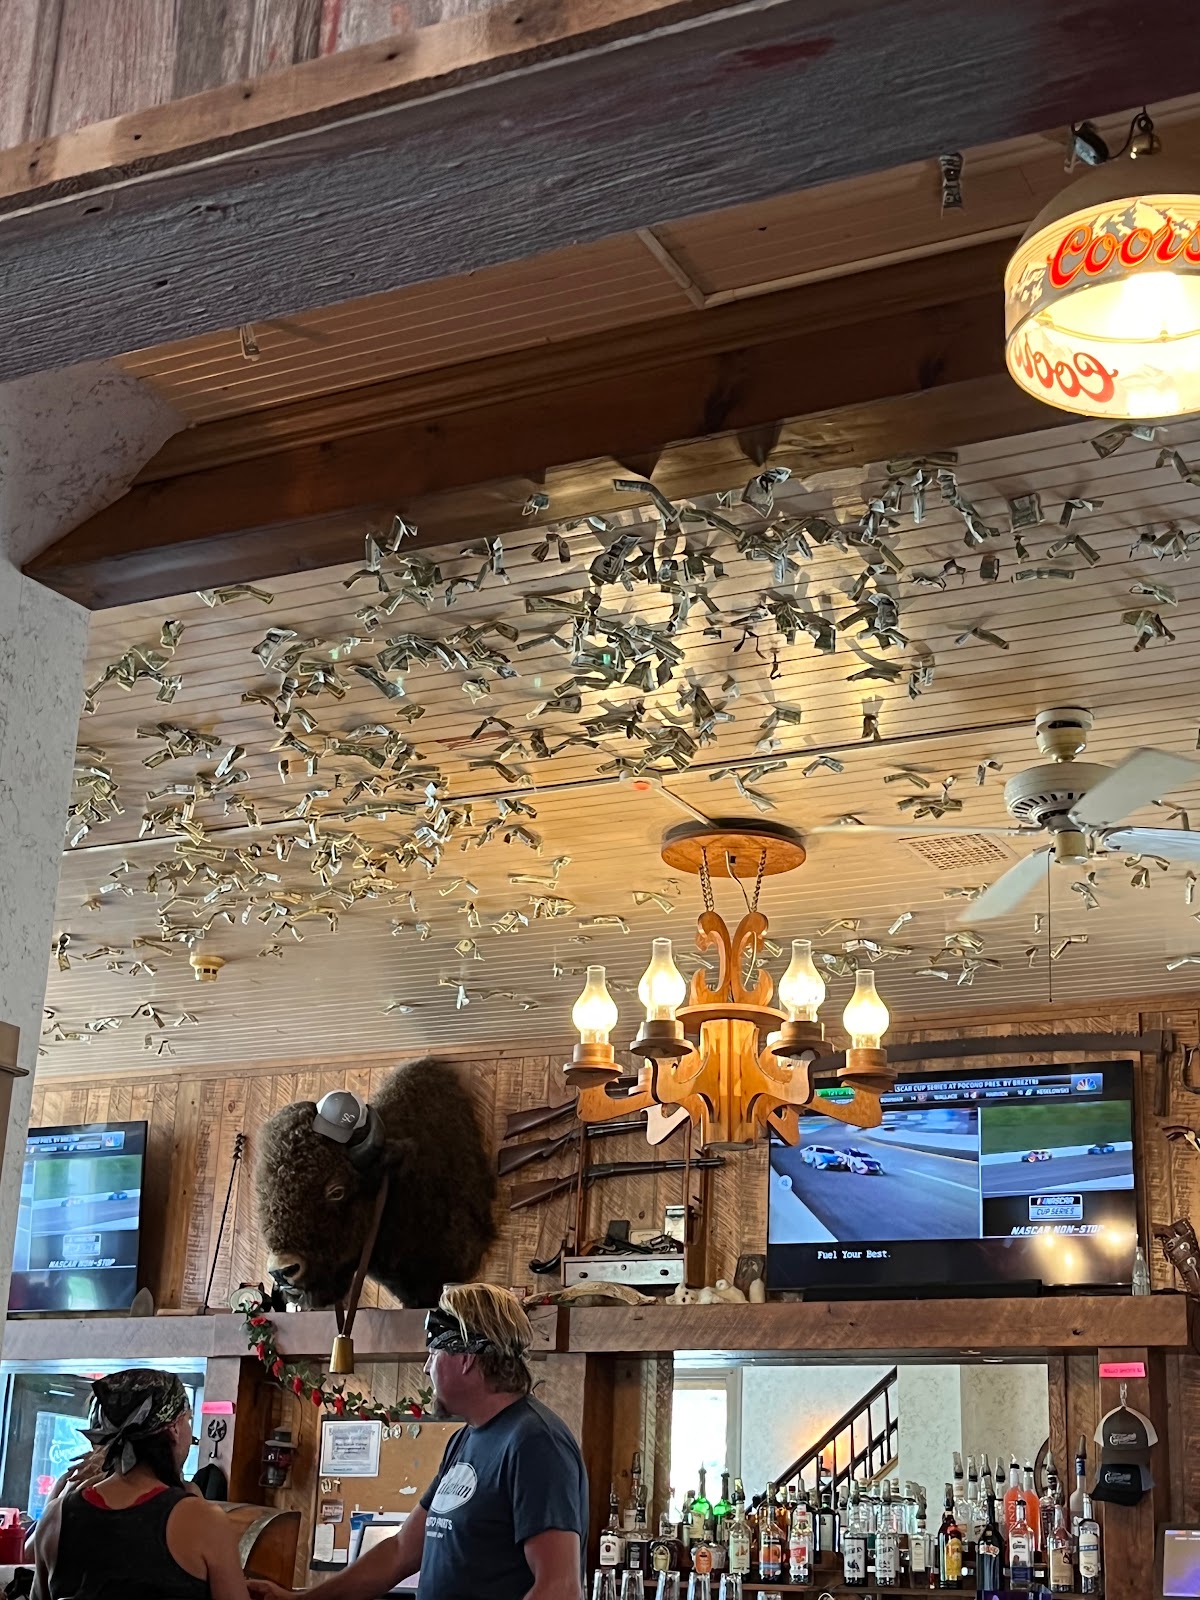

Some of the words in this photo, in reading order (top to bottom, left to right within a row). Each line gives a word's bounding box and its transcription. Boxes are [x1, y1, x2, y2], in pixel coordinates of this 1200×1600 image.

[1046, 216, 1200, 290] Coors
[895, 1085, 912, 1093] SCAR
[913, 1084, 926, 1092] CUP
[926, 1082, 947, 1091] SERIES
[948, 1082, 957, 1090] AT
[957, 1081, 983, 1090] POCONO
[1003, 1079, 1012, 1087] BY
[1041, 1197, 1075, 1205] NASCAR
[1036, 1208, 1051, 1216] CUP
[1051, 1207, 1075, 1215] SERIES
[1010, 1225, 1052, 1236] NASCAR
[1053, 1224, 1105, 1234] NON-STOP
[817, 1250, 838, 1260] Fuel
[841, 1249, 863, 1259] Your
[866, 1249, 892, 1259] Best.
[49, 1260, 77, 1268] NASCAR
